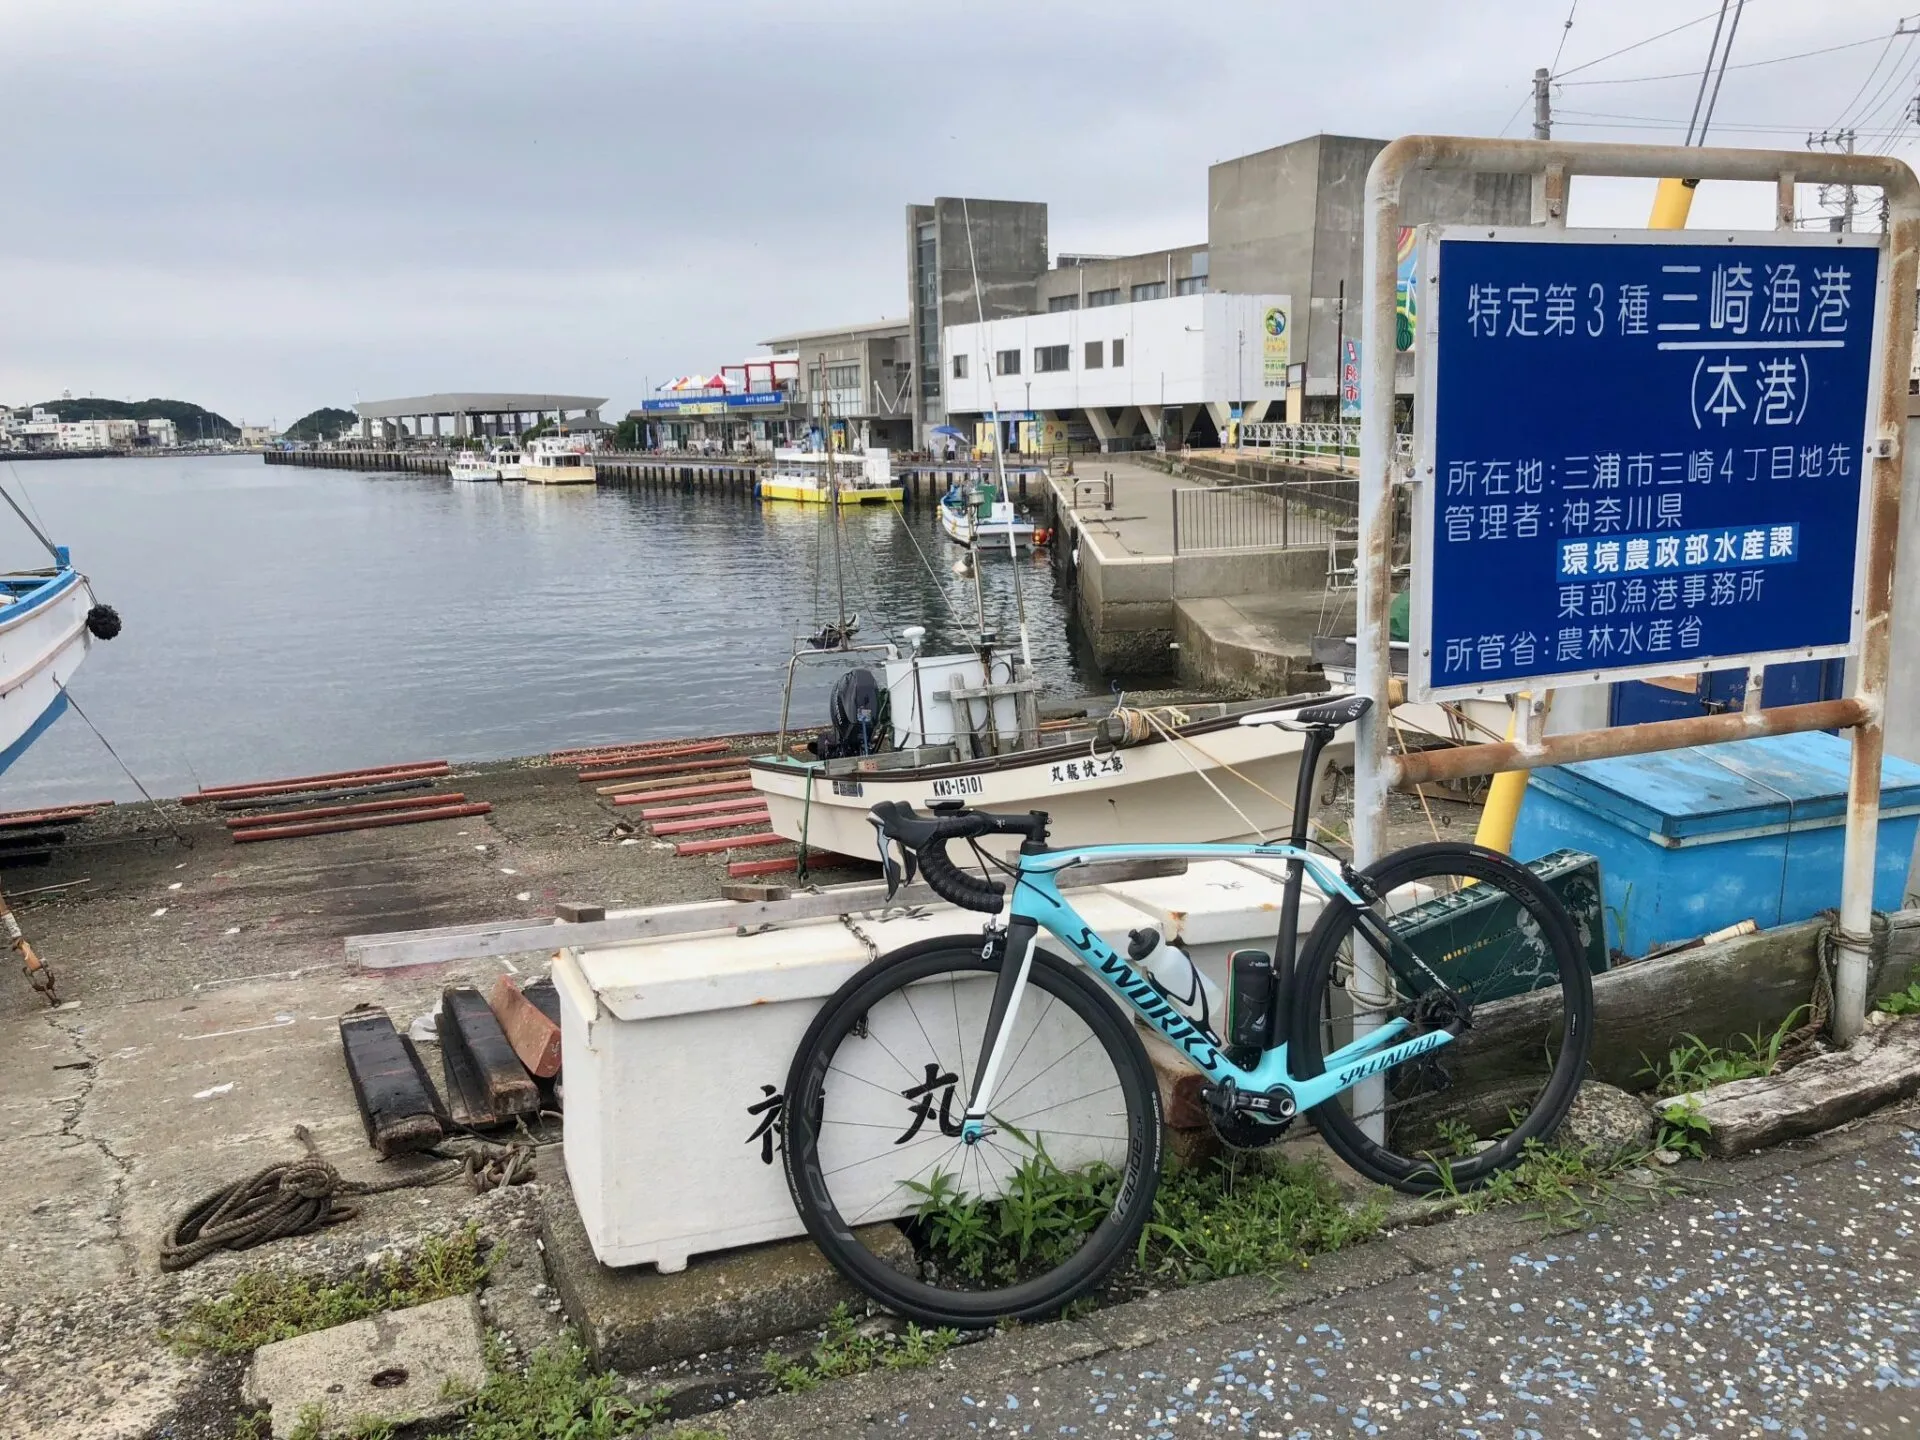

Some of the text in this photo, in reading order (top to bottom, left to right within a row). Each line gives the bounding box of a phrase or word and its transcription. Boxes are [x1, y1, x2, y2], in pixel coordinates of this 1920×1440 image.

[1690, 353, 1810, 430] (本港)
[1561, 525, 1794, 576] 環境農政部水産課
[1556, 568, 1765, 619] 東部漁港事務所
[1065, 926, 1229, 1072] S-WORKS
[1337, 1034, 1439, 1087] SPECIALIZED
